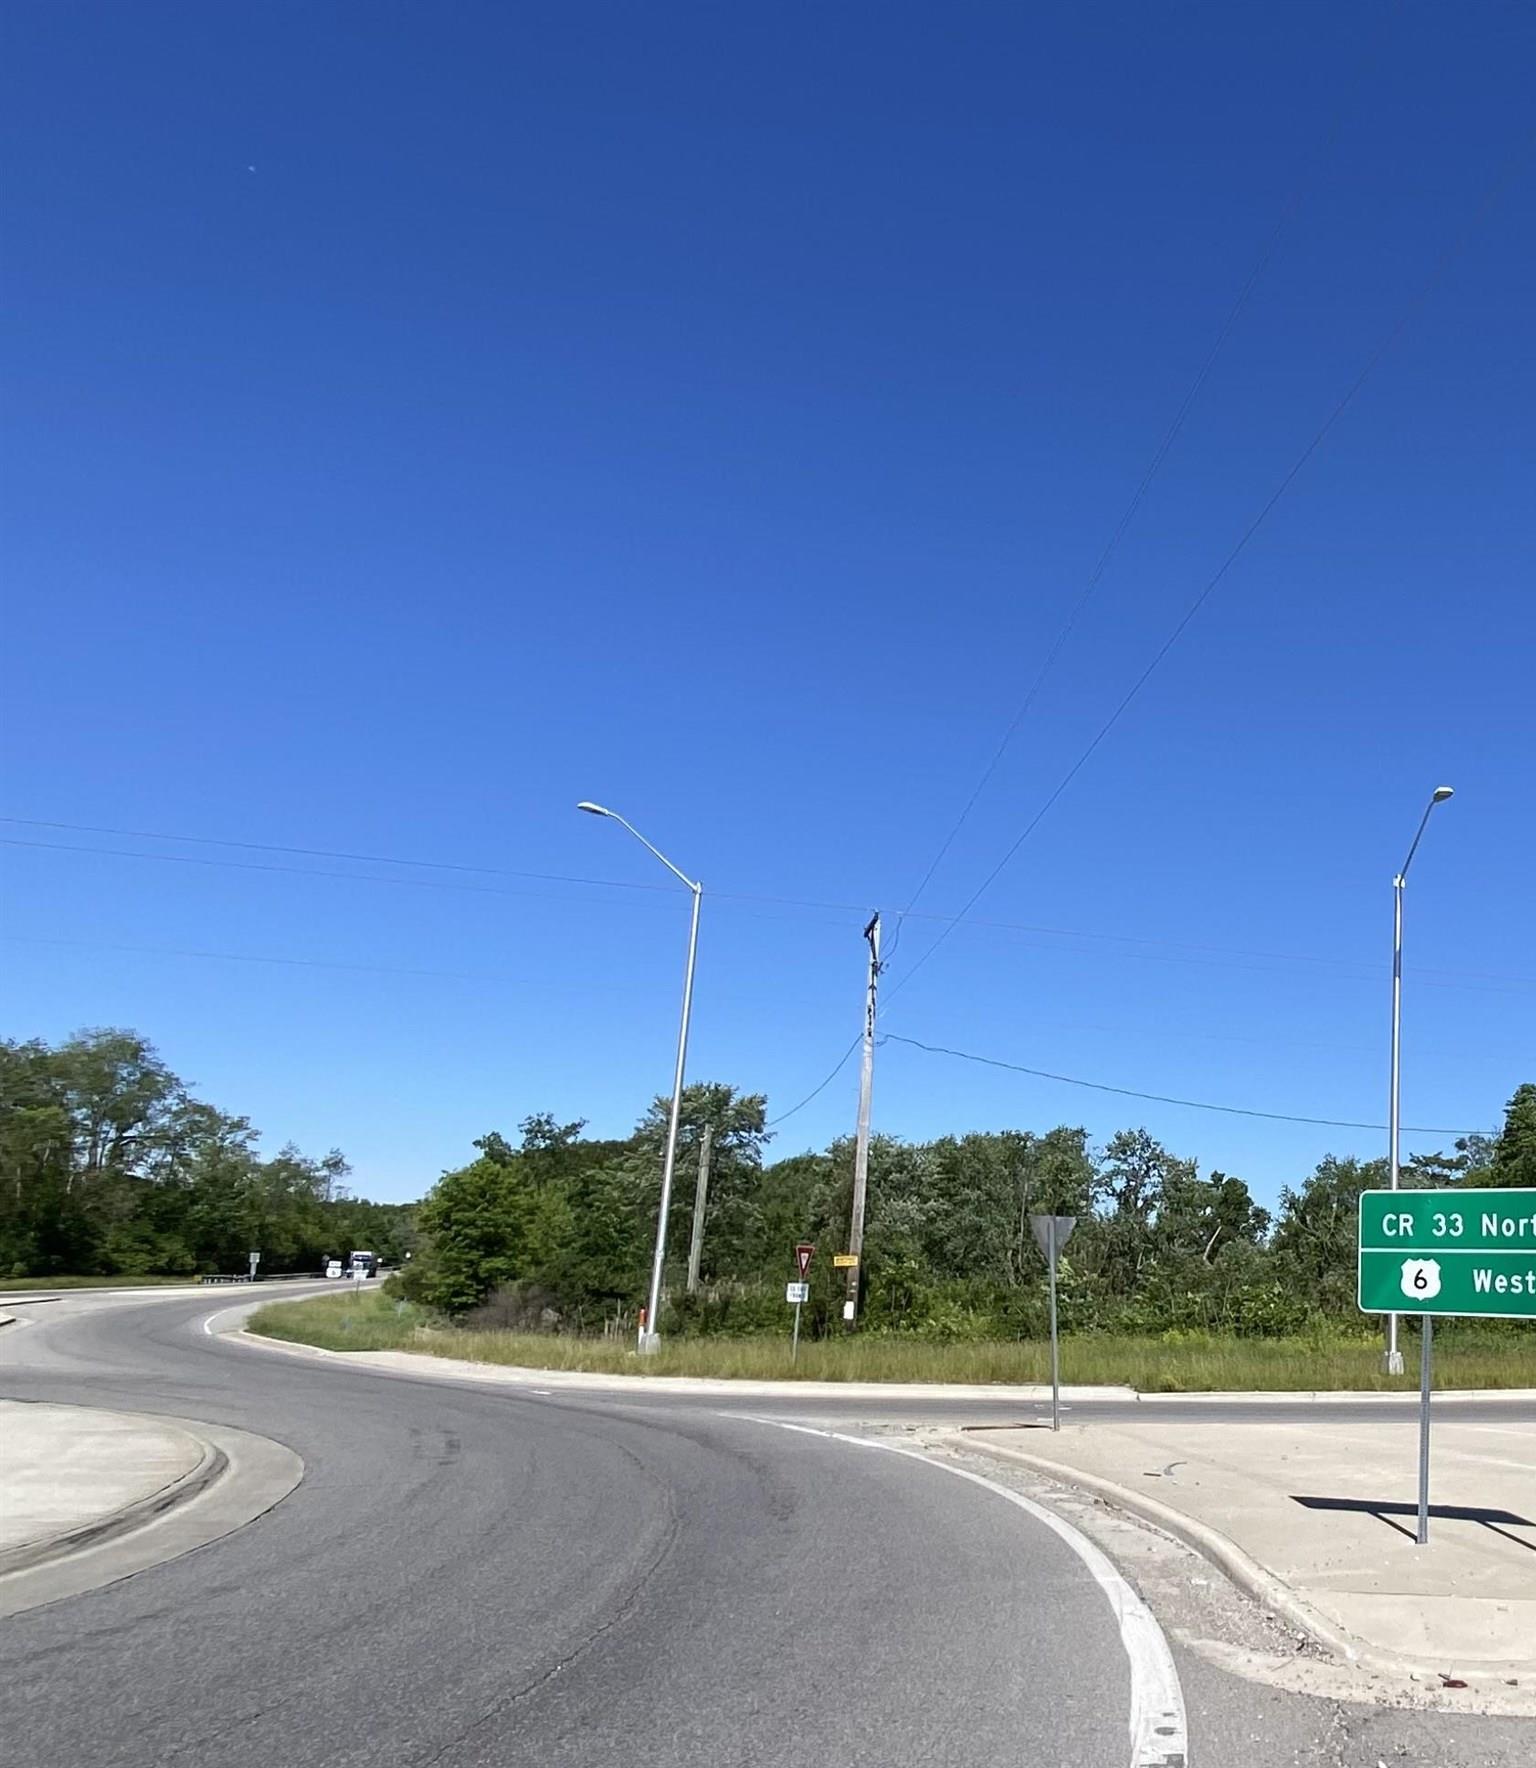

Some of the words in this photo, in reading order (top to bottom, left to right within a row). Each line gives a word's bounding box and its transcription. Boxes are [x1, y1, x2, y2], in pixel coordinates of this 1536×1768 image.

[1382, 1213, 1414, 1237] CR
[1432, 1213, 1464, 1237] 33
[1413, 1268, 1428, 1289] 6
[1473, 1269, 1536, 1294] West
